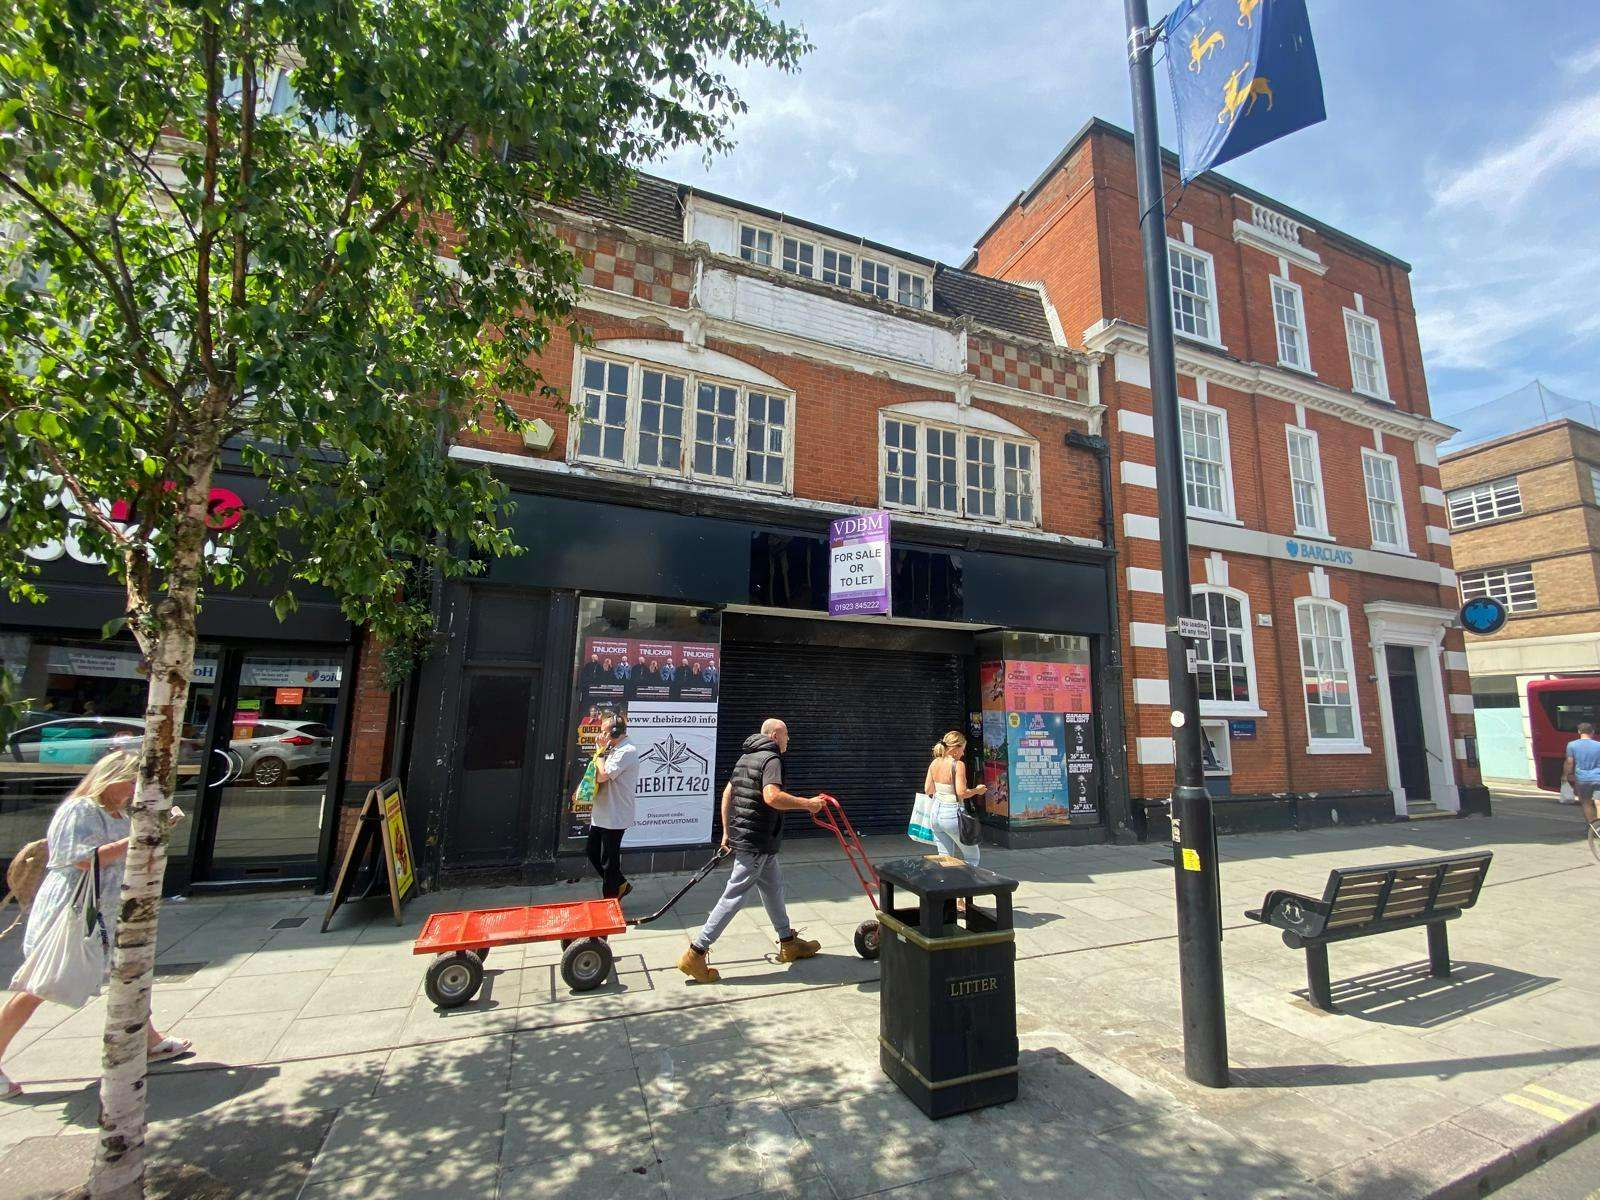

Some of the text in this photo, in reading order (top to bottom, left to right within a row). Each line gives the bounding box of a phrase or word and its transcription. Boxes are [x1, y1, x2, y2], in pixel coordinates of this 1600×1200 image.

[834, 514, 884, 536] VDBM
[834, 548, 881, 563] FOR SALE
[1301, 543, 1354, 565] BARCLAYS
[849, 564, 864, 573] OR
[840, 575, 874, 587] TO LET
[834, 601, 880, 611] 01923 845222
[1189, 621, 1207, 630] loading
[593, 646, 627, 654] TINLICKER
[640, 648, 672, 656] TINLICKER
[682, 650, 715, 658] TINLICKER
[635, 776, 710, 793] HEBITZ420
[951, 978, 998, 997] LITTER
